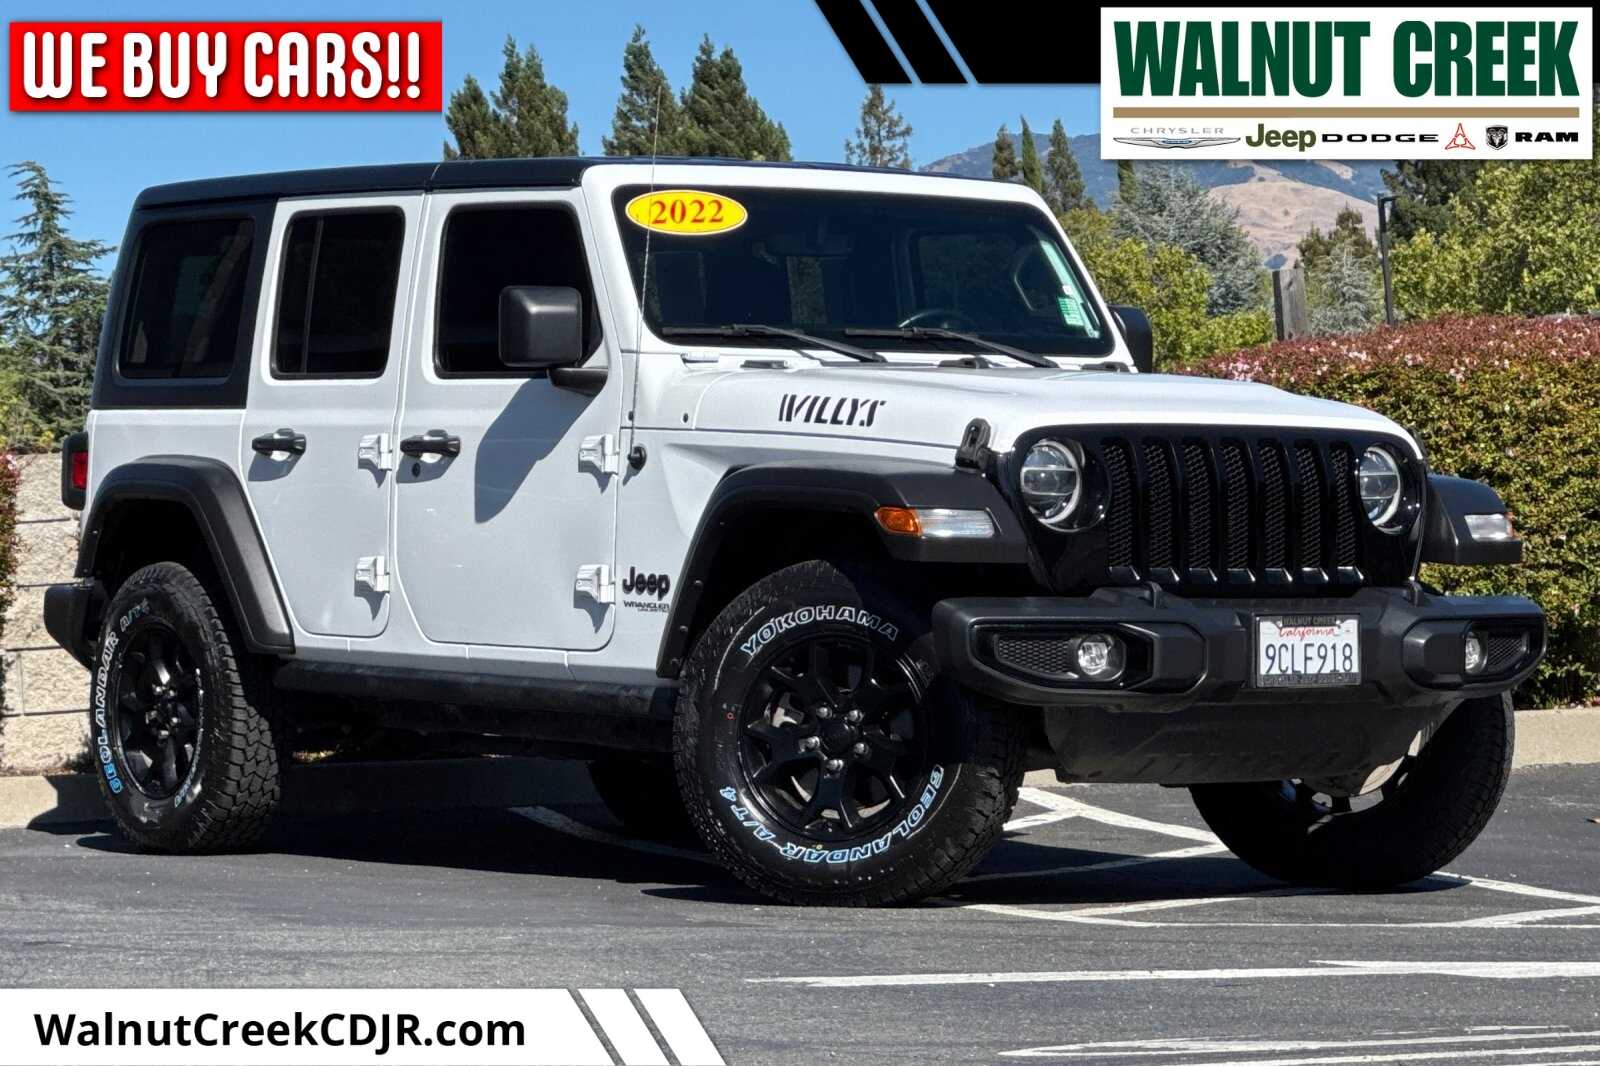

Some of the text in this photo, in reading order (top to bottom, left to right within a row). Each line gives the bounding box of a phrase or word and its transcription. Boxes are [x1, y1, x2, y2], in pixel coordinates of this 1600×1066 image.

[650, 199, 724, 224] 2022
[778, 393, 887, 427] WILLYS
[622, 566, 671, 601] Jeep
[740, 604, 899, 657] YOKOHAMA
[1265, 643, 1353, 674] 9CLF918
[95, 631, 123, 795] GEOLANDAR
[779, 763, 945, 864] GEOLANDAR
